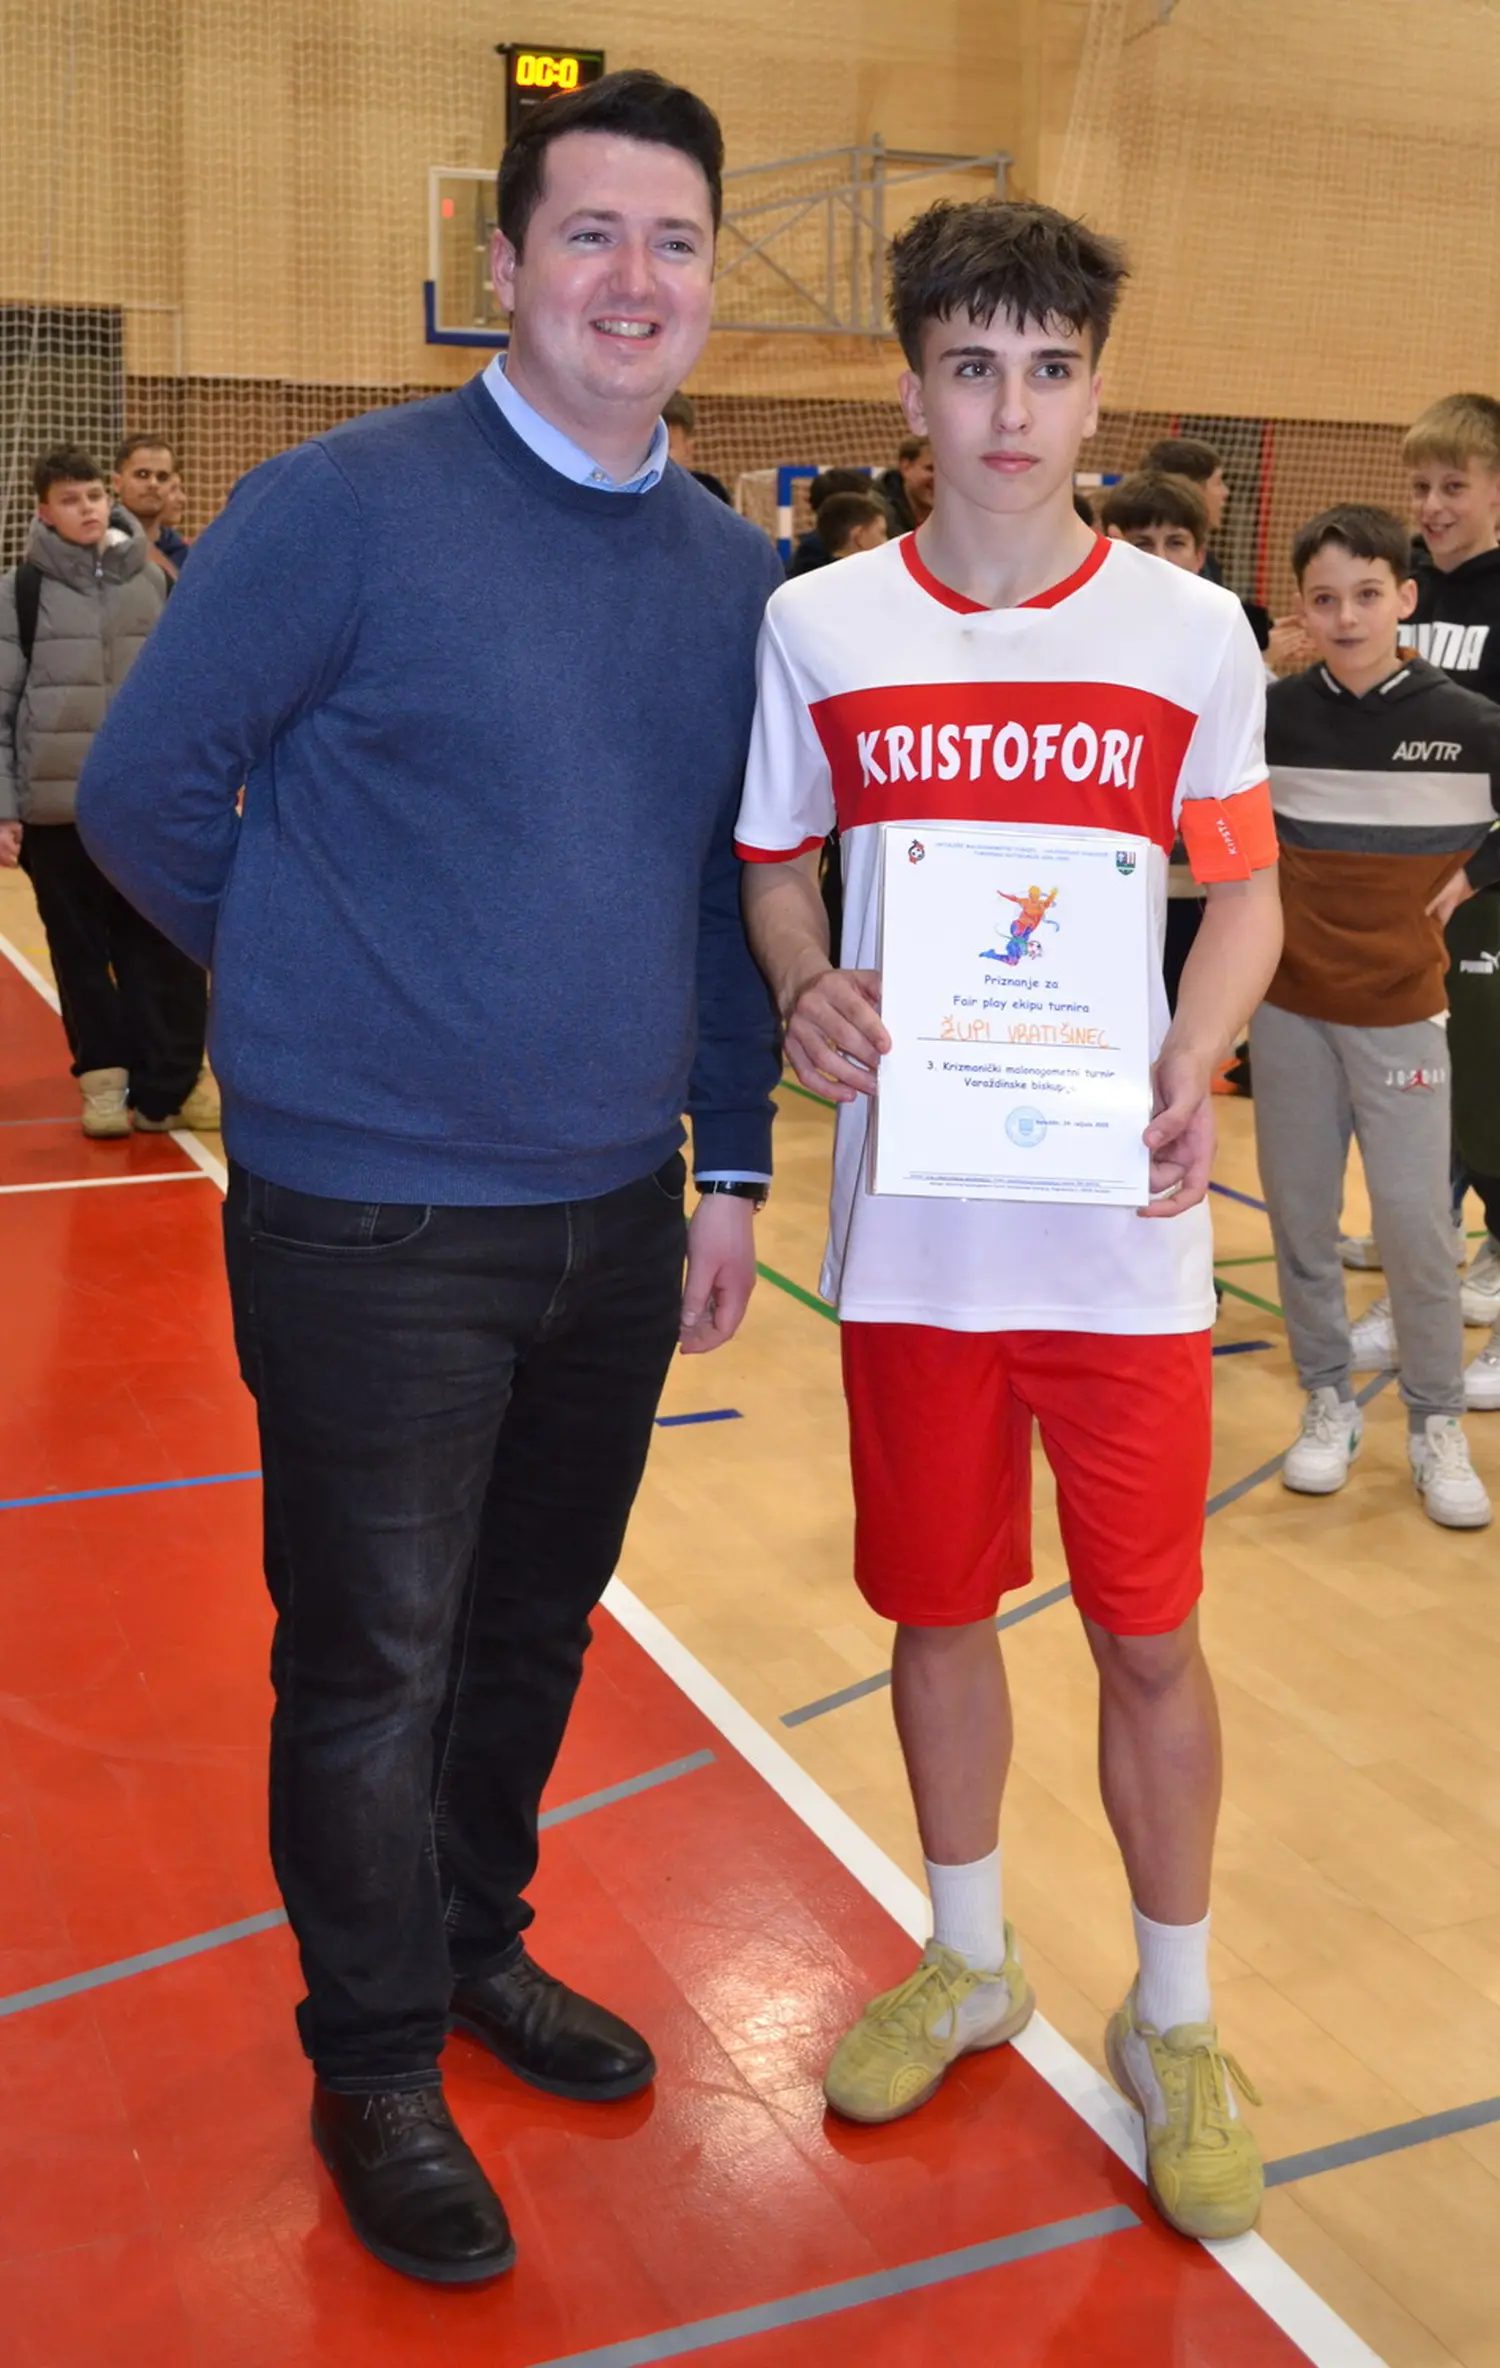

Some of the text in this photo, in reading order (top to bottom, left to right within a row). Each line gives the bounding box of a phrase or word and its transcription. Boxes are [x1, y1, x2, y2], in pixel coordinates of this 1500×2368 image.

[857, 721, 1144, 790] KRISTOFORI
[1392, 740, 1463, 762] ADVTR
[1215, 818, 1238, 855] KIPSTA
[984, 974, 1059, 990] Priznanje za
[953, 995, 1090, 1013] Fair play ekipu turnira
[940, 1015, 1109, 1049] ŽUPI VRATIŠINEC
[926, 1060, 938, 1072] 3.
[942, 1062, 1002, 1074] Krizmanički
[1005, 1064, 1081, 1079] malonogometni
[964, 1077, 1027, 1090] Varaždinske
